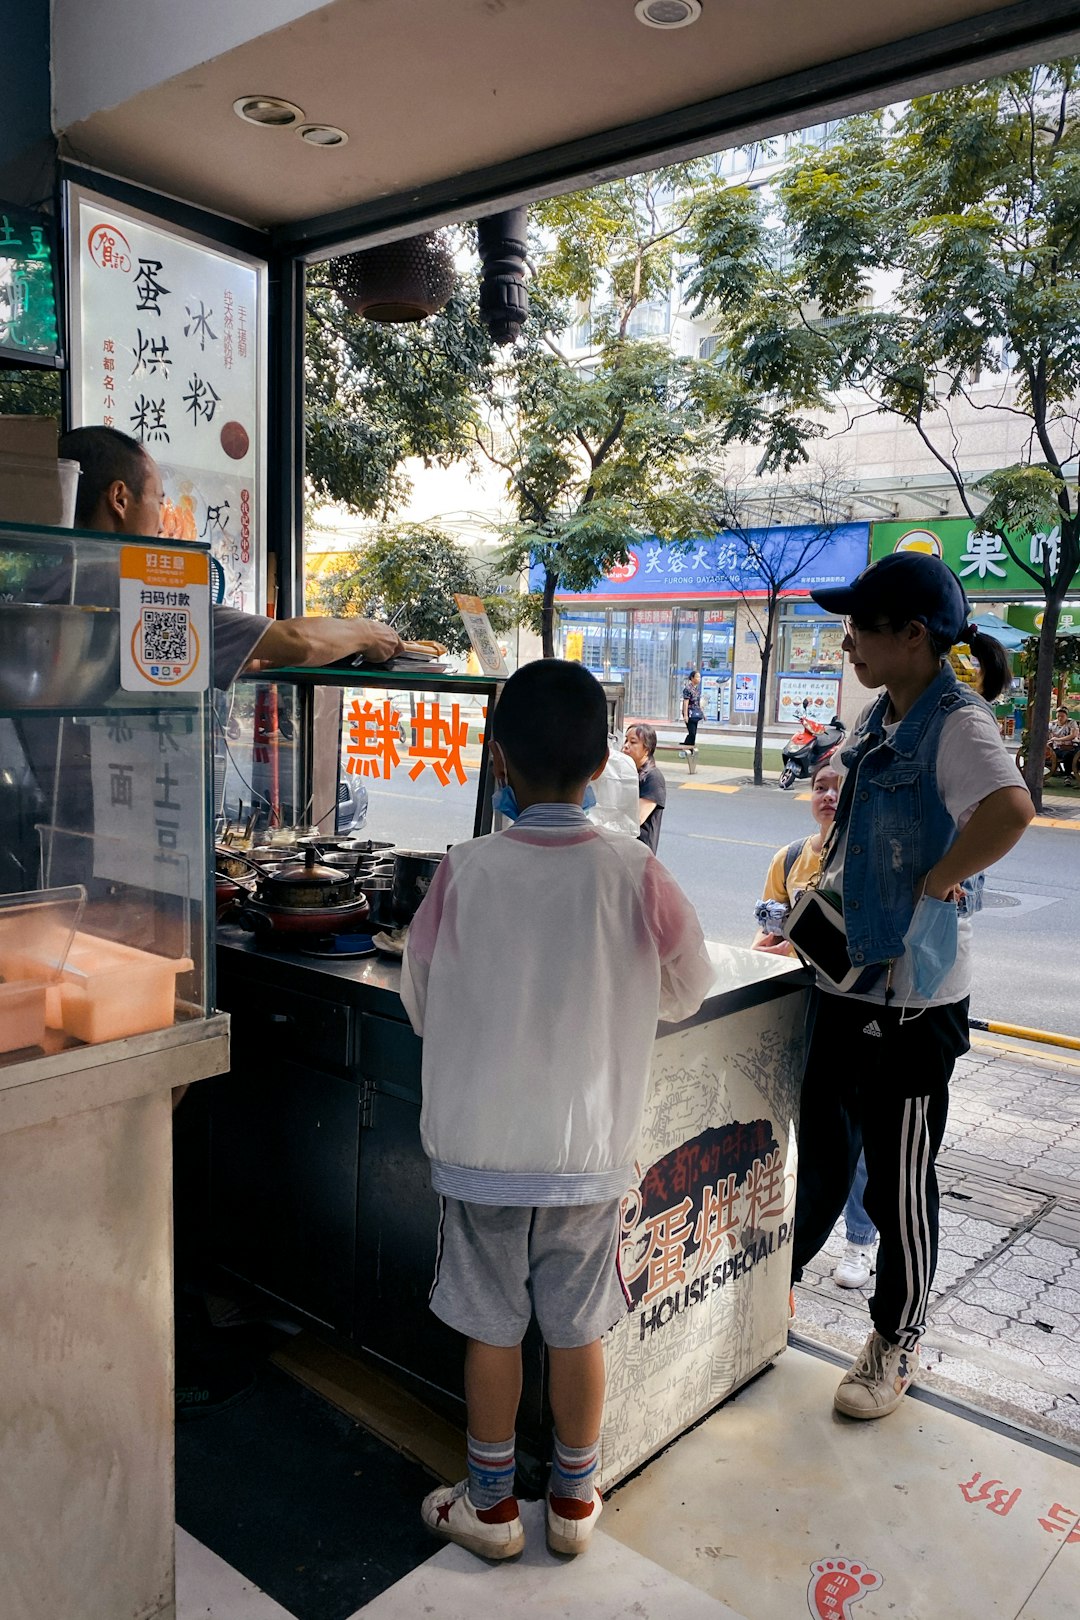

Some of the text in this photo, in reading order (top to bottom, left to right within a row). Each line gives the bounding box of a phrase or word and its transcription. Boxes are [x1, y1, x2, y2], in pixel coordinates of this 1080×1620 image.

[130, 258, 172, 444] 蛋烘糕
[182, 300, 221, 427] 冰粉
[145, 553, 185, 570] 好生意
[664, 576, 694, 585] FURONG
[140, 590, 190, 607] 扫码付款
[639, 1272, 711, 1341] HOUSE
[711, 1235, 776, 1292] SPECIAL
